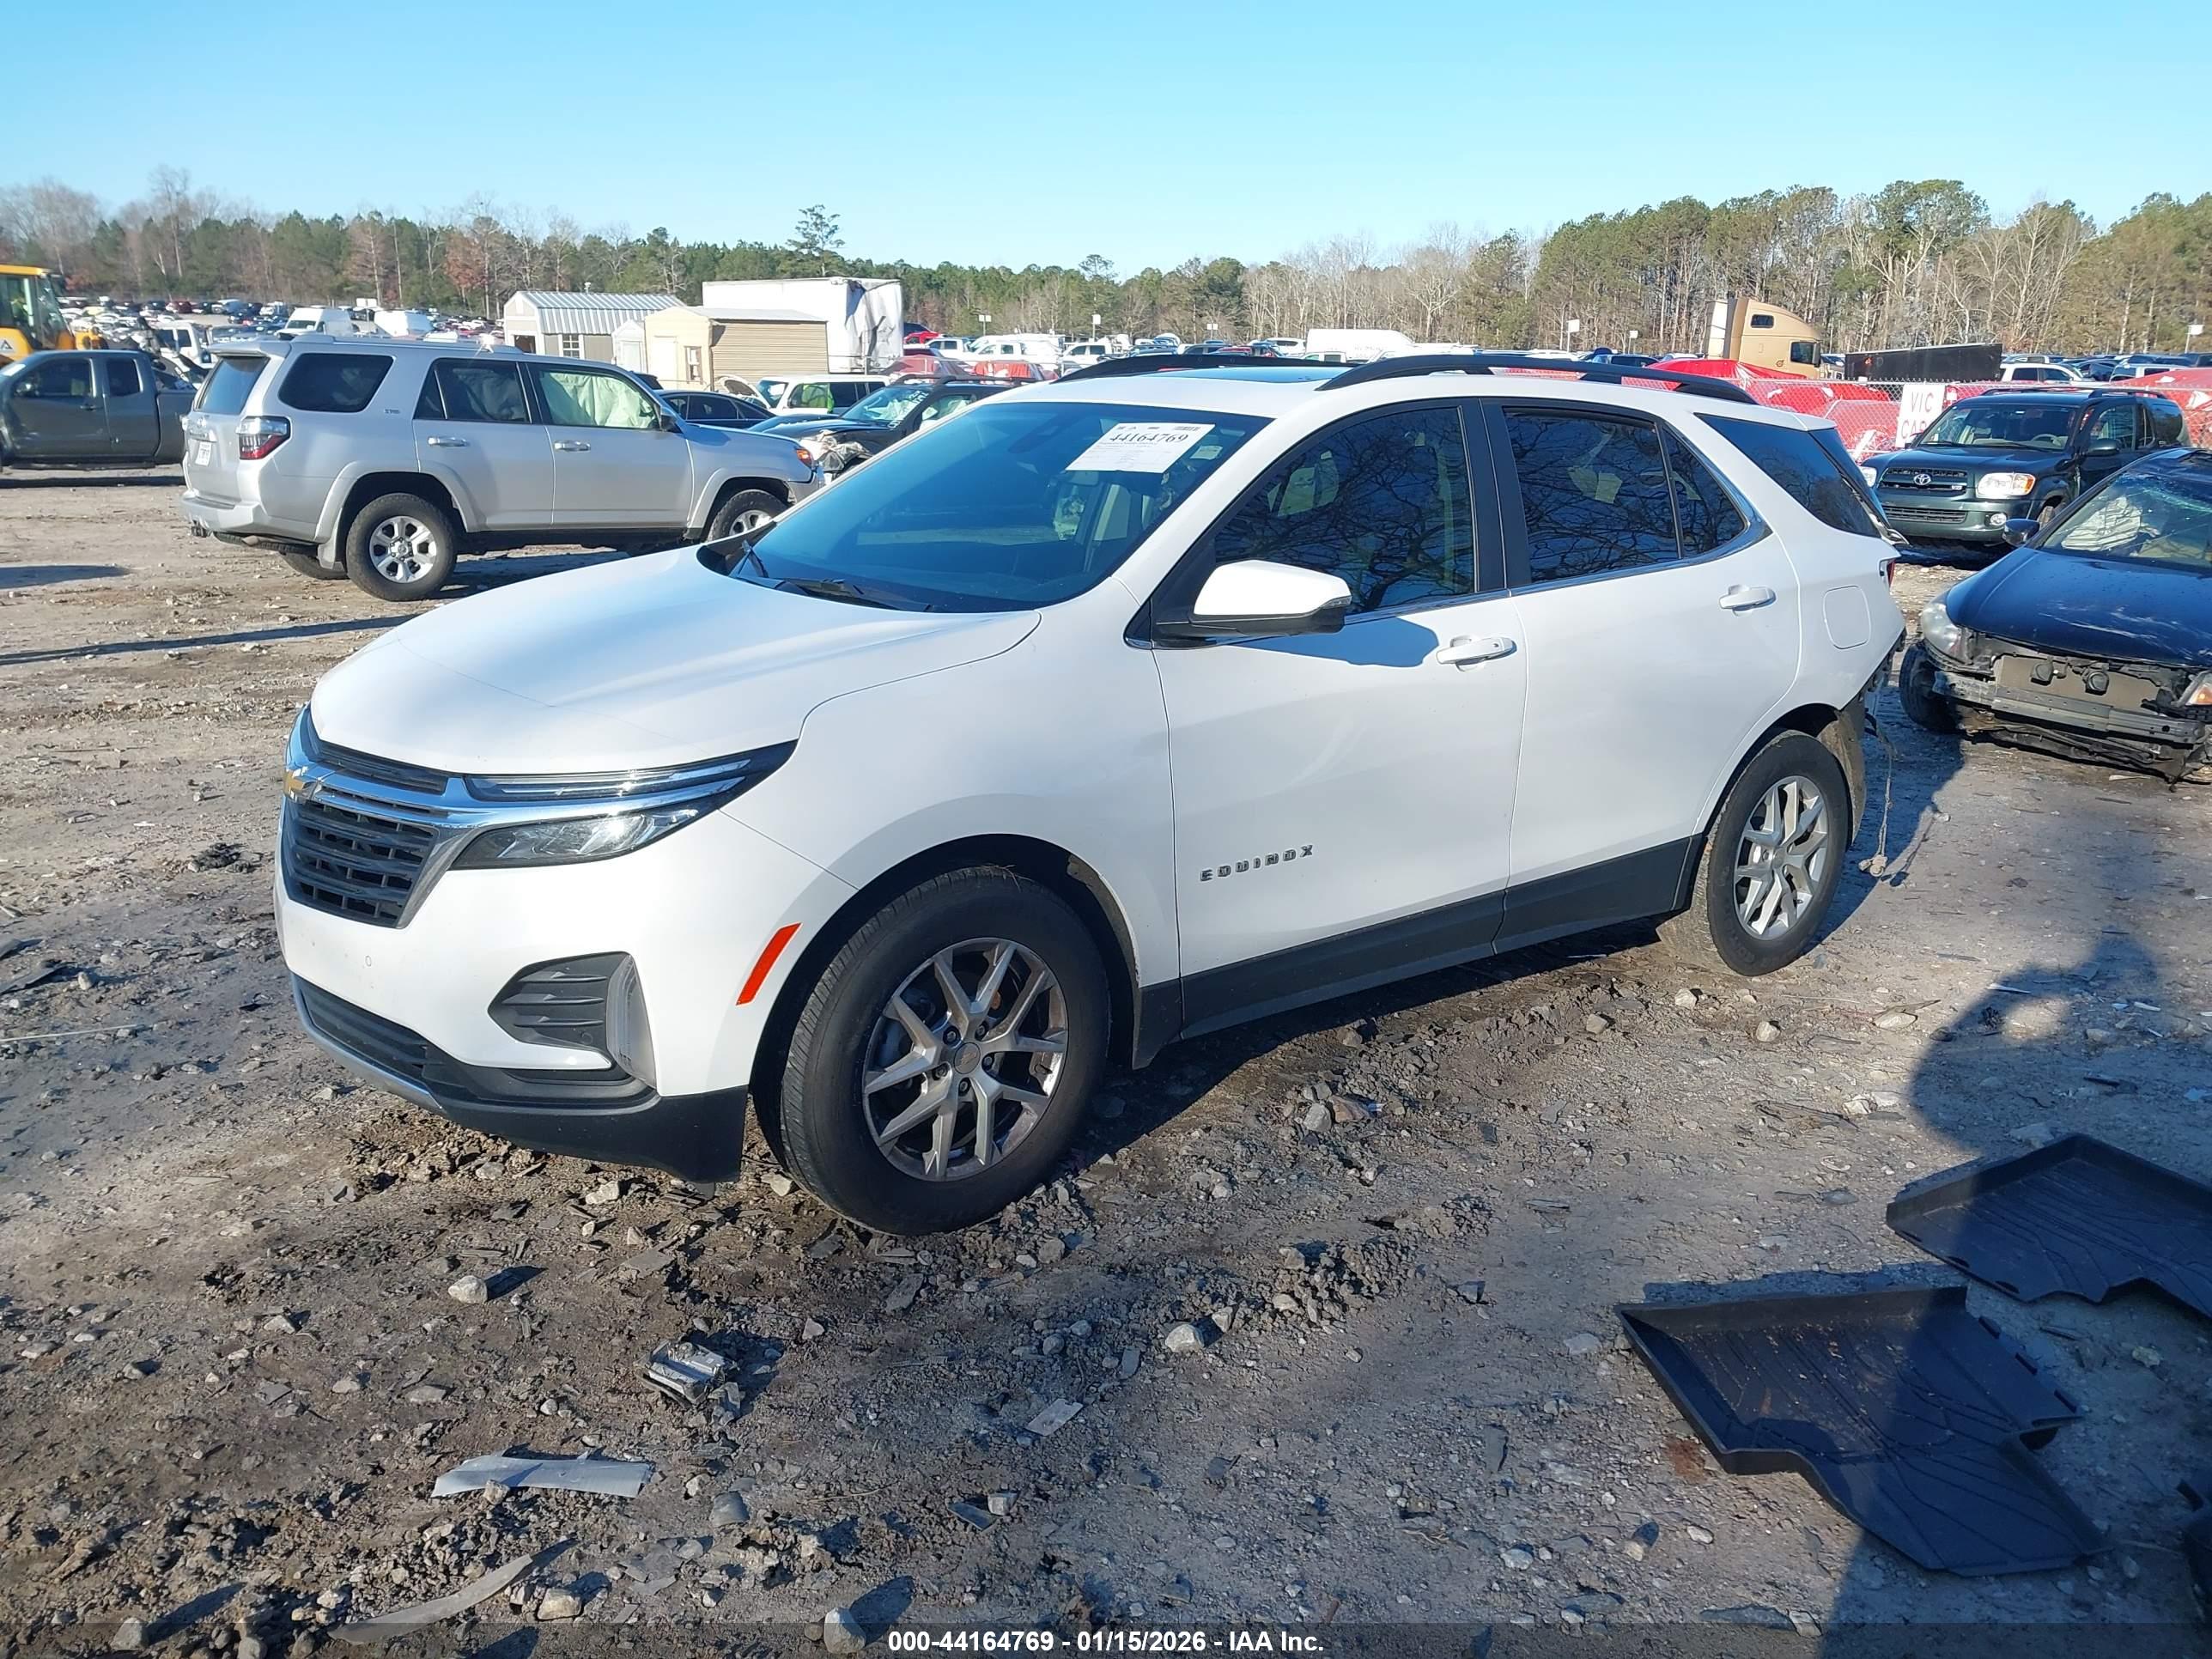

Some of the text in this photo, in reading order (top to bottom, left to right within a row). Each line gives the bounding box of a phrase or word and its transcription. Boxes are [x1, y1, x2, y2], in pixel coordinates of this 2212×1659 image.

[1911, 392, 1934, 412] VIC
[1109, 433, 1189, 443] 44164769
[1200, 844, 1314, 882] EQUINOX
